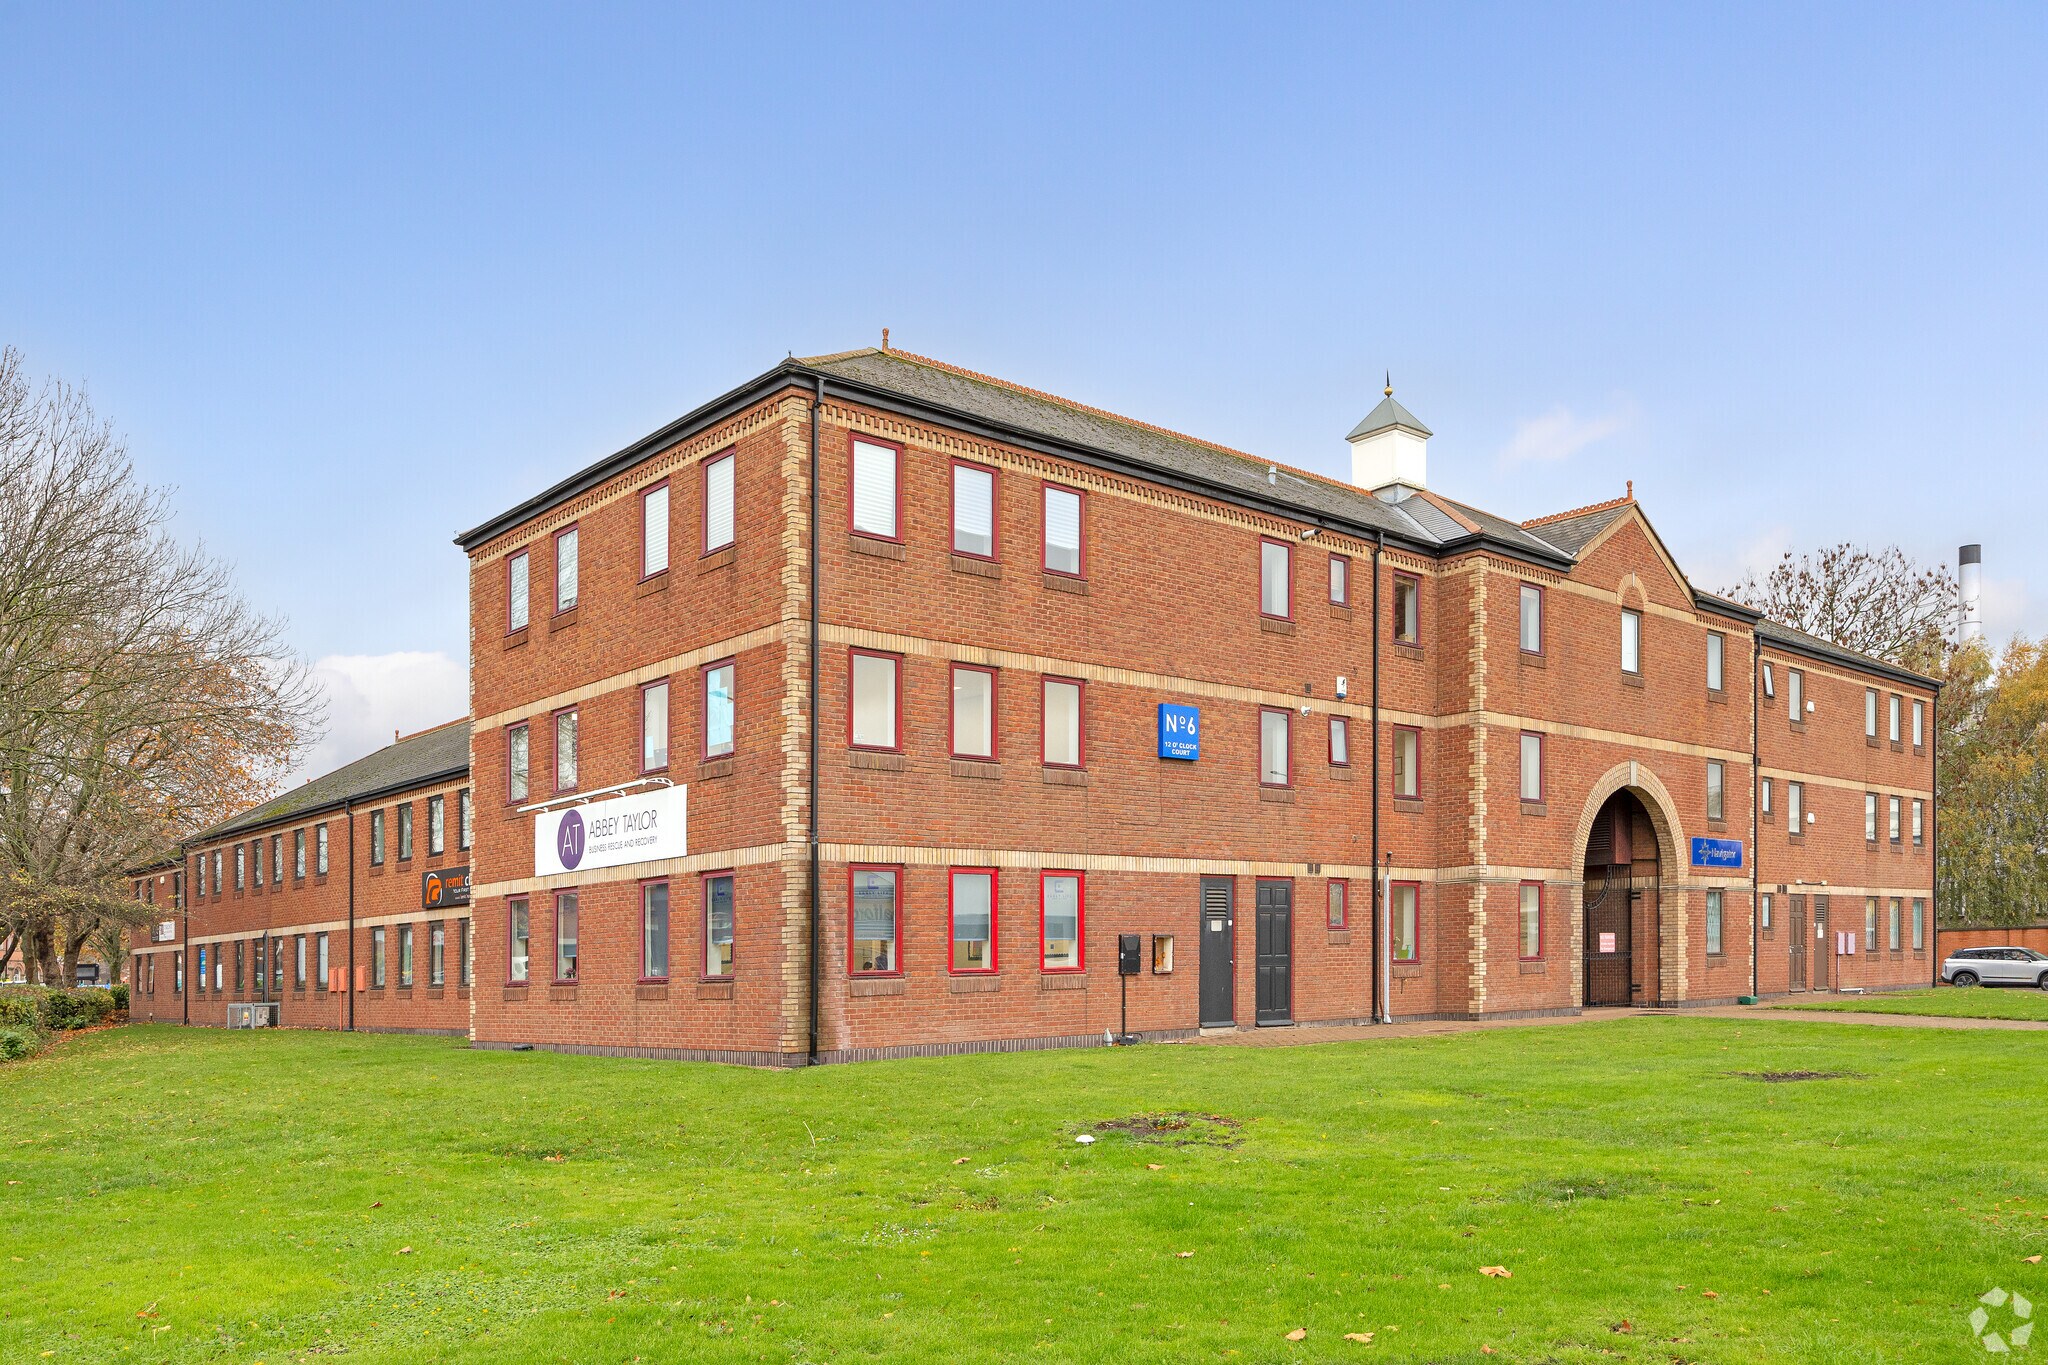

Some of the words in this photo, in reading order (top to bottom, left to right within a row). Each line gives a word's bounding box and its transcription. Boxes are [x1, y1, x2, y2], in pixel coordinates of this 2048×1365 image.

[1178, 742, 1197, 750] CLOCK
[588, 816, 620, 839] ABBEY
[622, 809, 658, 833] TAYLOR
[562, 823, 581, 857] AT
[588, 843, 607, 854] BUSINESS
[607, 840, 623, 851] RESCUE
[624, 839, 634, 848] AND
[635, 835, 658, 847] RECOVERY
[1711, 847, 1737, 861] Navigator
[445, 873, 464, 888] remit
